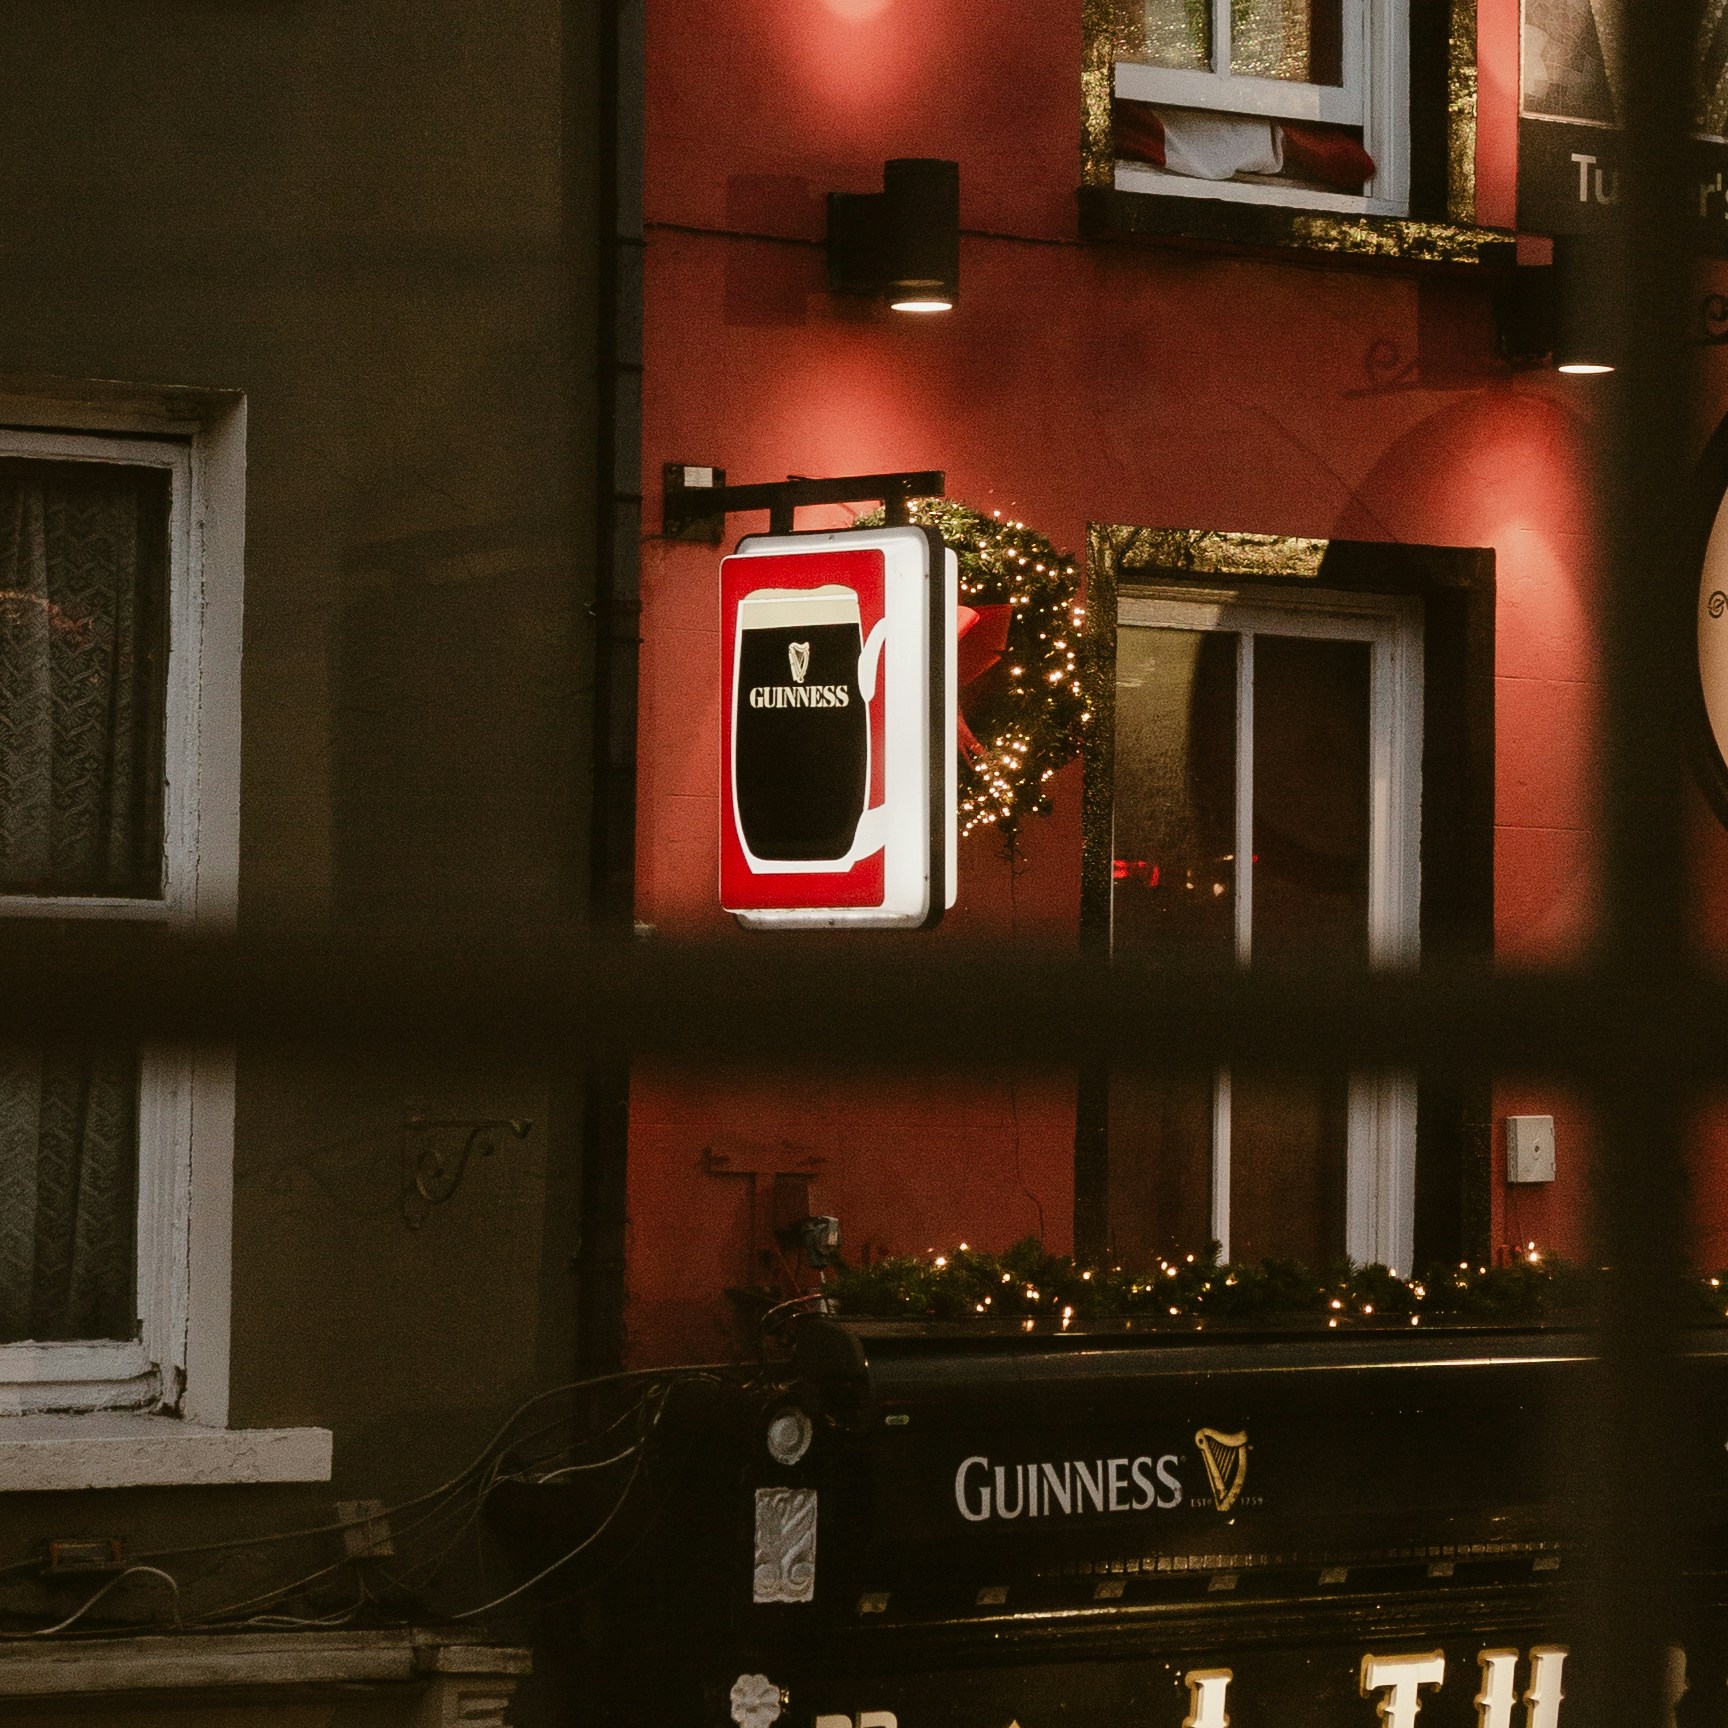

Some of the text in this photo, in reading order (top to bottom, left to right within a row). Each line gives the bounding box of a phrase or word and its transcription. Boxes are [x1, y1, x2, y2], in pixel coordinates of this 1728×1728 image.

[749, 685, 850, 709] GUINNESS
[954, 1454, 1183, 1522] GUINNESS
[1240, 1496, 1264, 1507] 1759
